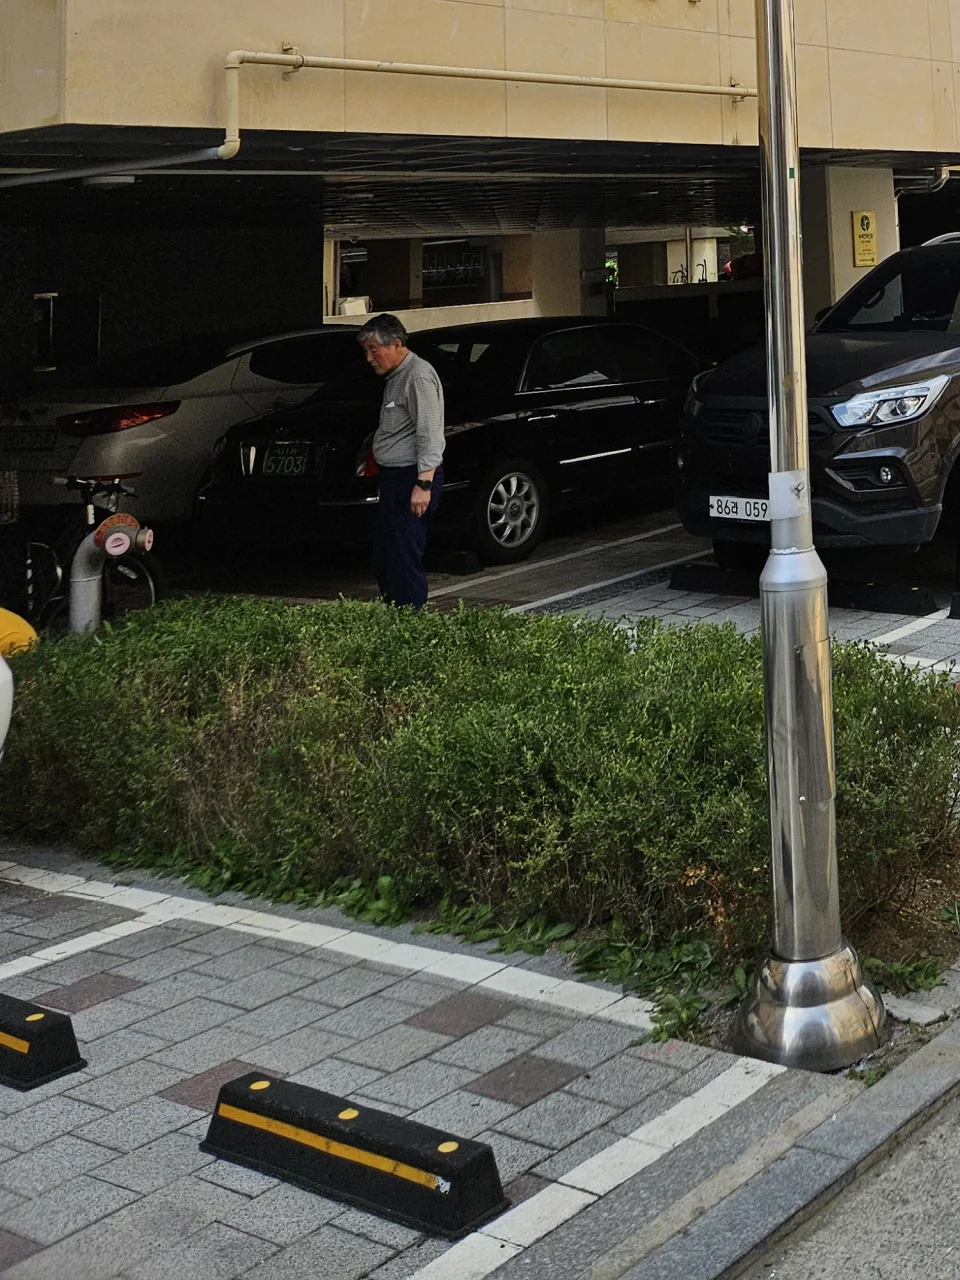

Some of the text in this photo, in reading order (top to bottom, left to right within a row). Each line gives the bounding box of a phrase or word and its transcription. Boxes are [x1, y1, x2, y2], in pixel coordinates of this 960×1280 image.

[266, 456, 303, 473] 5703
[716, 499, 769, 518] 86라 059
